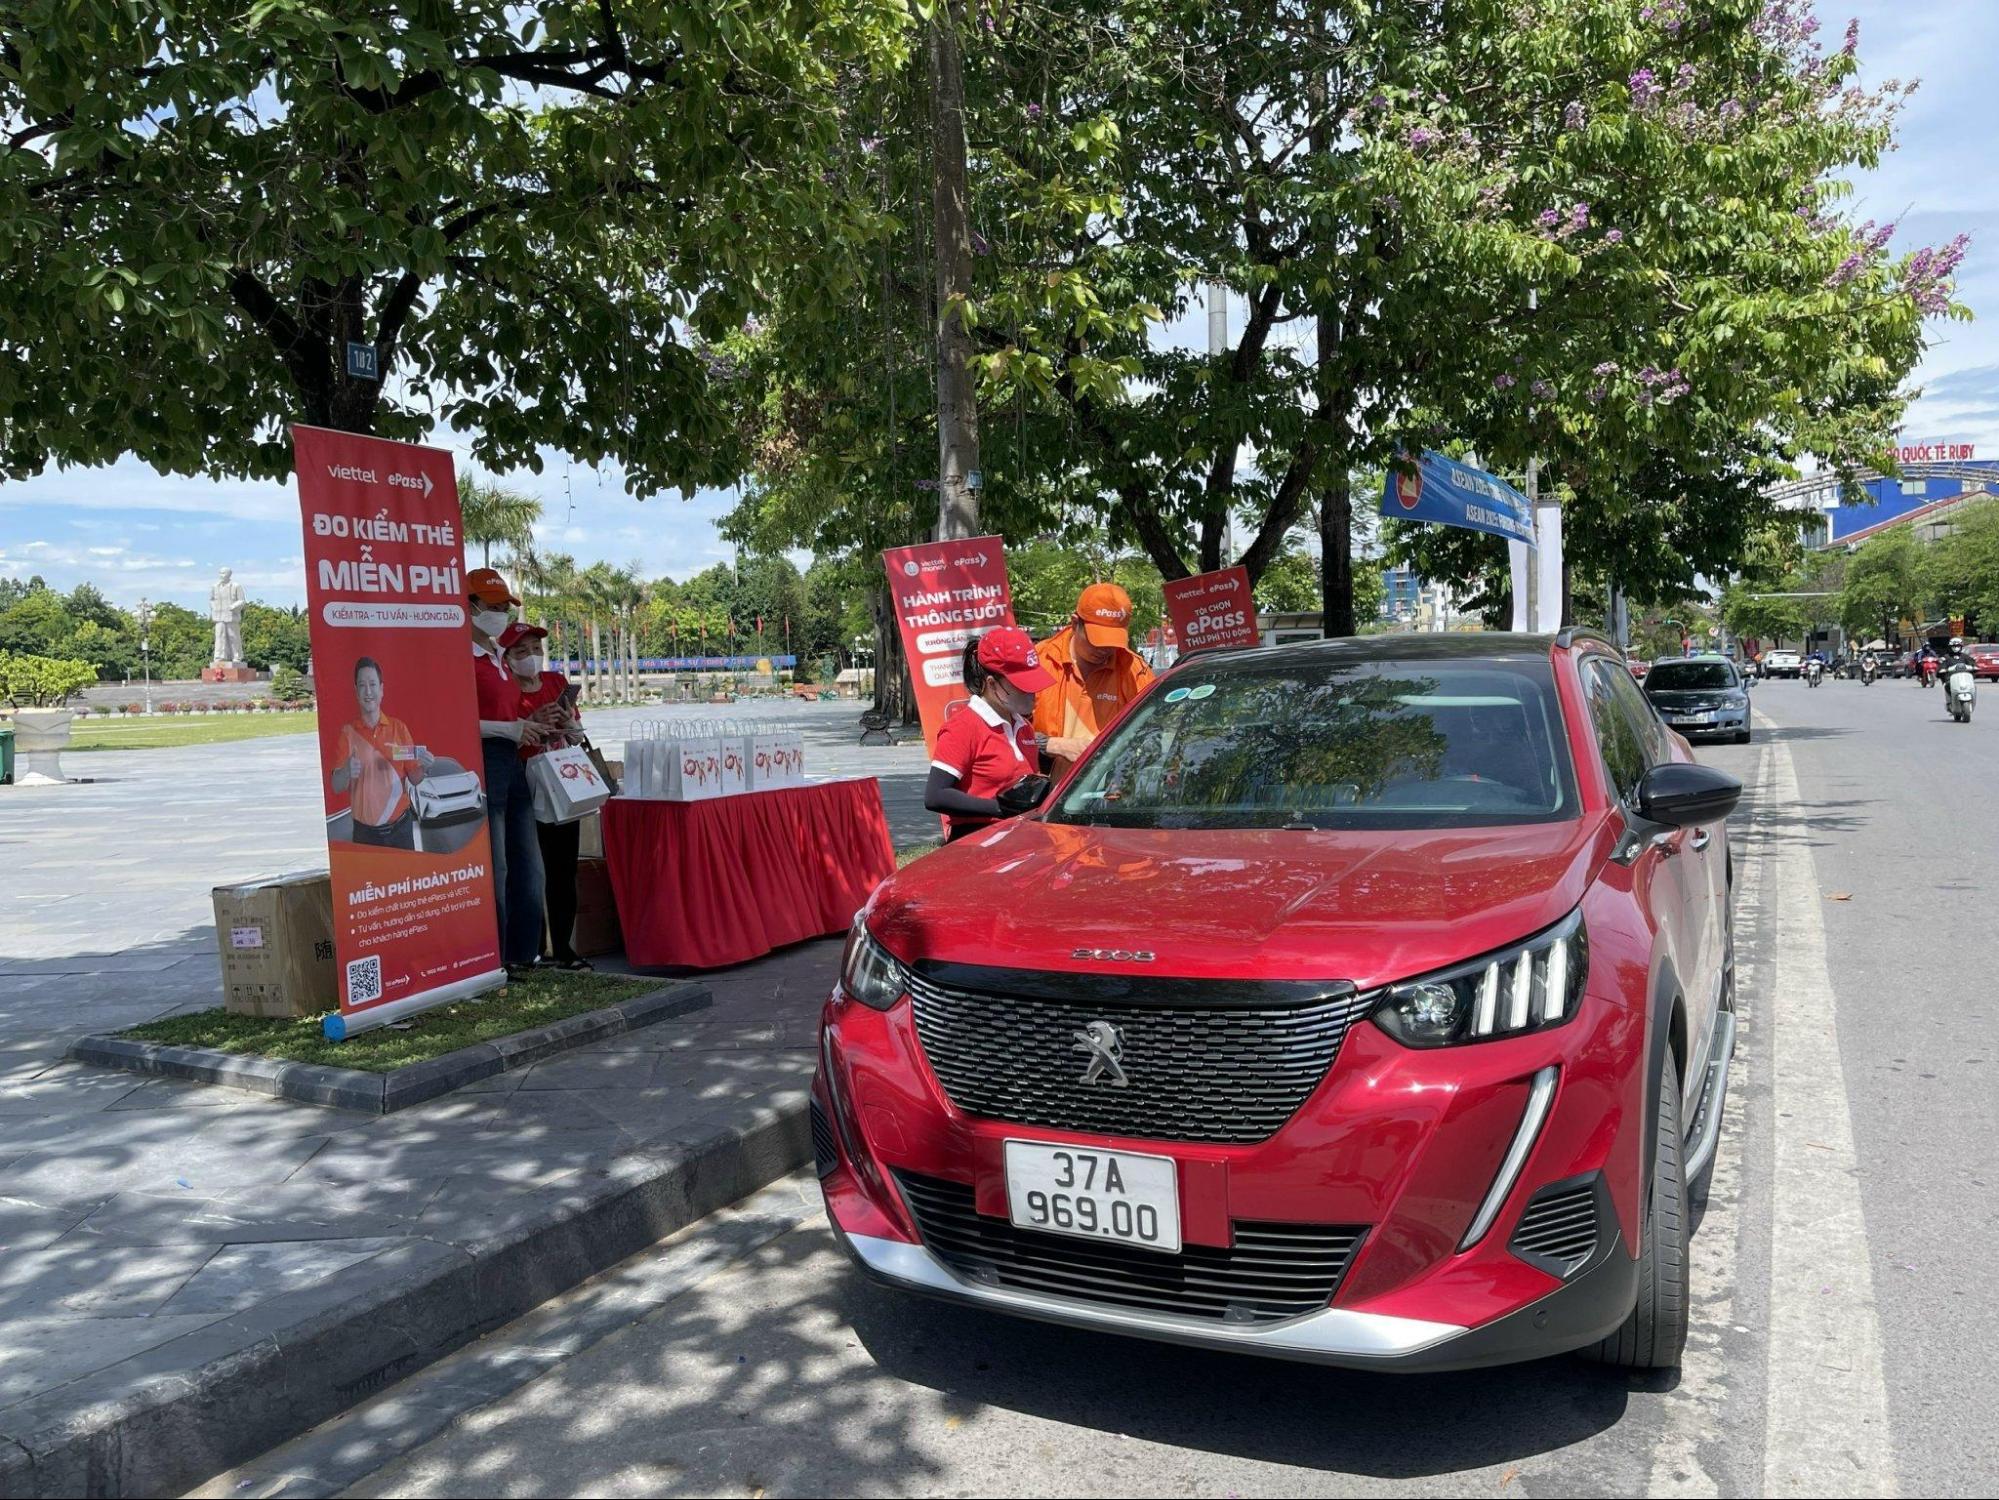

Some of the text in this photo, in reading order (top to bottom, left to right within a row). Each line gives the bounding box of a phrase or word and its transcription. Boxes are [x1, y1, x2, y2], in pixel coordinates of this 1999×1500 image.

[1949, 444, 1975, 460] RUBY
[327, 464, 424, 490] viettel ePass
[313, 508, 456, 547] ĐO KIỂM THẺ
[318, 544, 461, 595] MIỄN PHÍ
[954, 557, 981, 568] ePass
[902, 583, 1003, 609] HÀNH TRÌNH
[1209, 582, 1233, 594] ePass
[354, 610, 370, 620] TRA
[905, 598, 1008, 629] THÔNG SUỐT
[1095, 608, 1122, 618] ePass
[1208, 600, 1231, 613] CHỌN
[1186, 610, 1245, 636] ePass
[1185, 636, 1206, 648] THU
[1206, 631, 1221, 642] PHÍ
[349, 863, 484, 906] MIỄN PHÍ HOÀN TOÀN
[1053, 1151, 1126, 1194] 37A
[1027, 1190, 1159, 1242] 969.00
